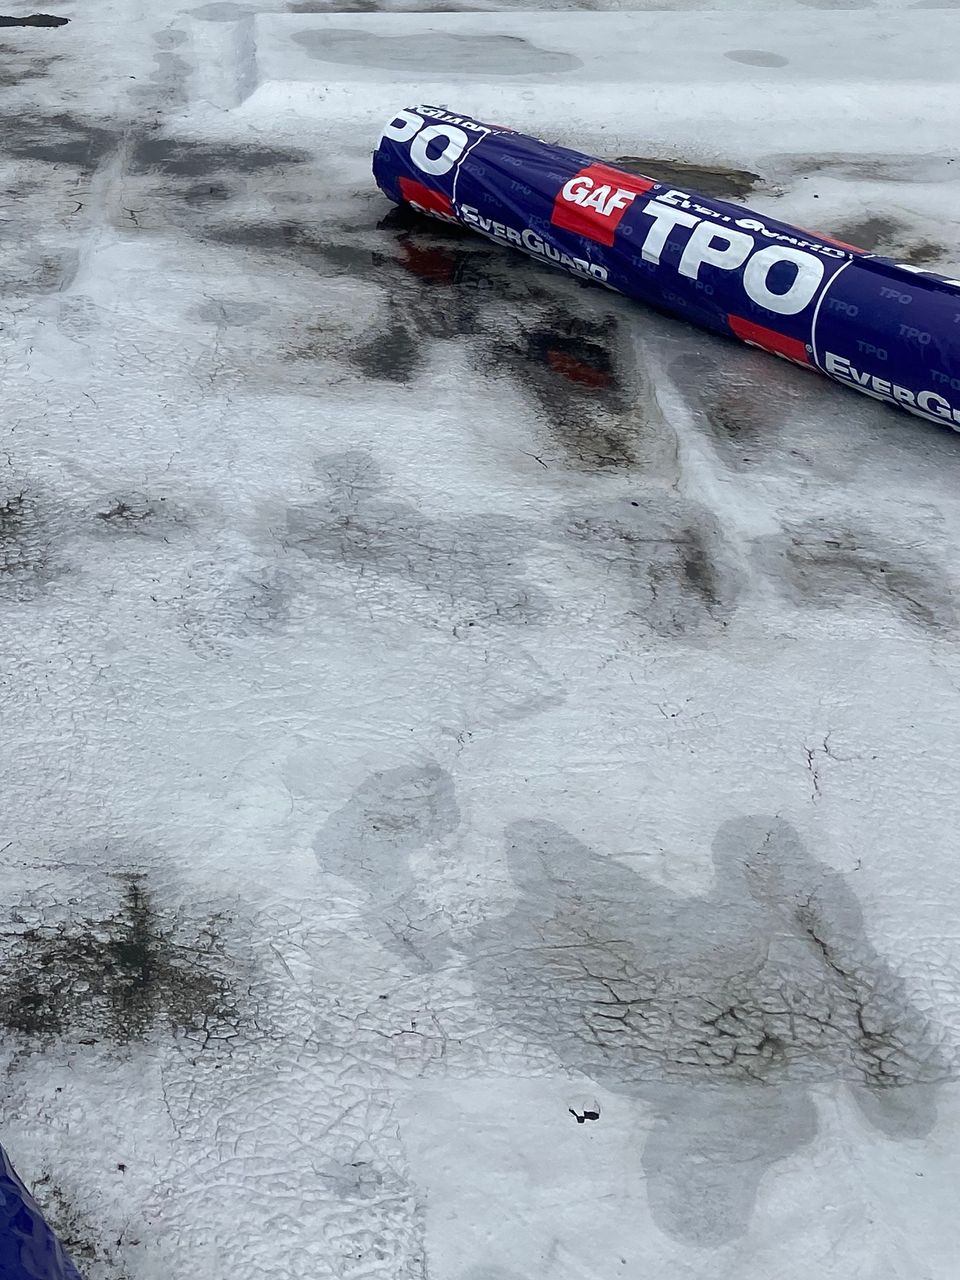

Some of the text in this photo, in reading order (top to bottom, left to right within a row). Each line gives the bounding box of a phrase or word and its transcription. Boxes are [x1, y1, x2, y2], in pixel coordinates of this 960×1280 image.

[562, 176, 636, 216] GAF
[460, 204, 608, 282] EVERGUARD
[642, 200, 824, 315] TPO
[880, 286, 912, 304] TPO
[829, 298, 858, 317] TPO
[898, 324, 932, 344] TPO
[856, 340, 887, 360] TPO
